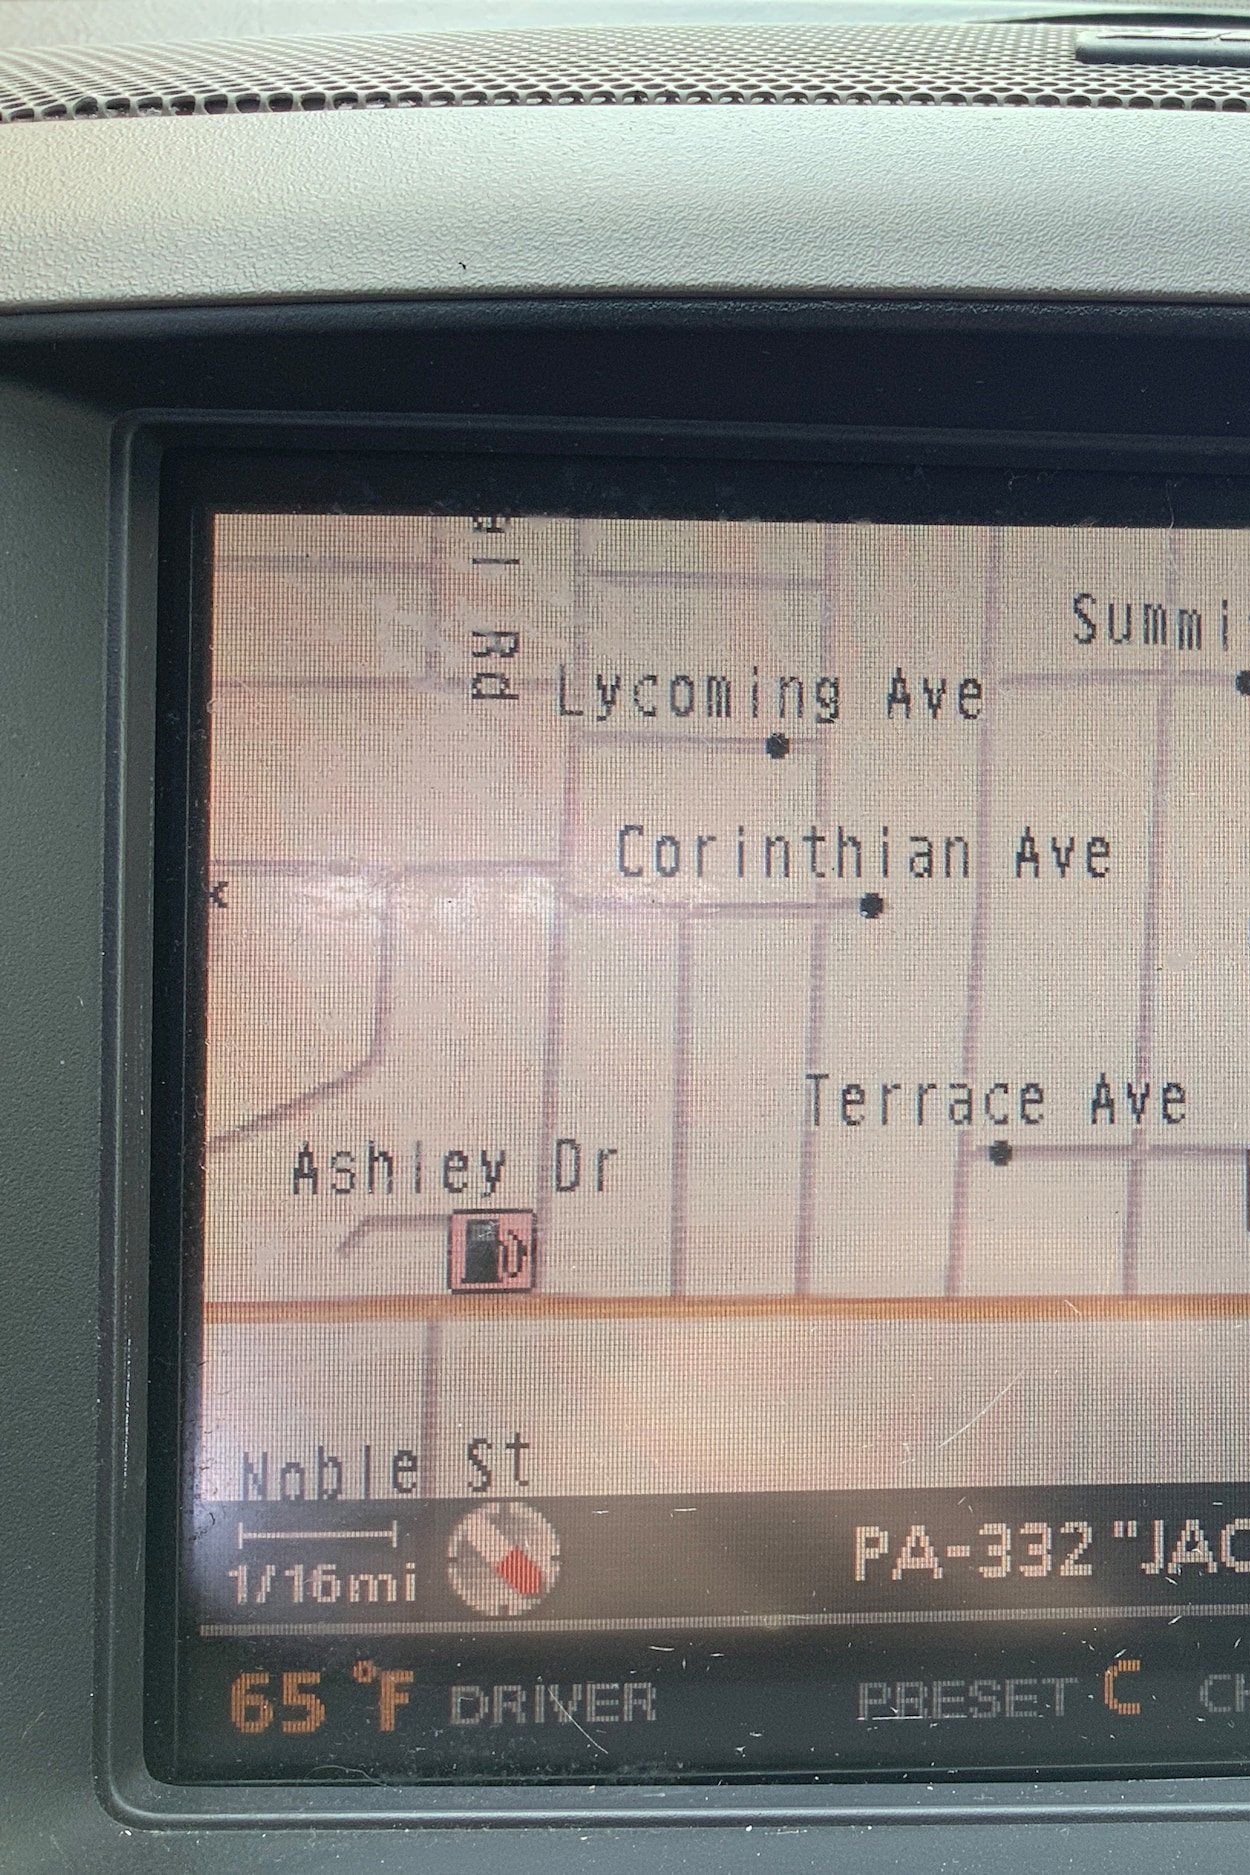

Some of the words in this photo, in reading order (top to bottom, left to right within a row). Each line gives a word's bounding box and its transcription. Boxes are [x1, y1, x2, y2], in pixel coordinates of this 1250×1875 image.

[471, 630, 520, 700] Rd
[558, 664, 841, 724] Lycoming
[887, 667, 983, 721] Ave
[617, 824, 972, 879] Corinthian
[1015, 825, 1112, 879] Ave
[804, 1073, 1046, 1127] Terrace
[1090, 1071, 1188, 1127] Ave
[291, 1139, 506, 1197] Ashley
[554, 1137, 617, 1193] Dr
[242, 1444, 419, 1501] Noble
[466, 1431, 531, 1494] St
[854, 1521, 1093, 1582] PA-332
[227, 1561, 417, 1605] 1/16mi
[449, 1681, 658, 1727] DRIVER
[857, 1676, 1079, 1721] PRESET
[1103, 1659, 1142, 1715] C
